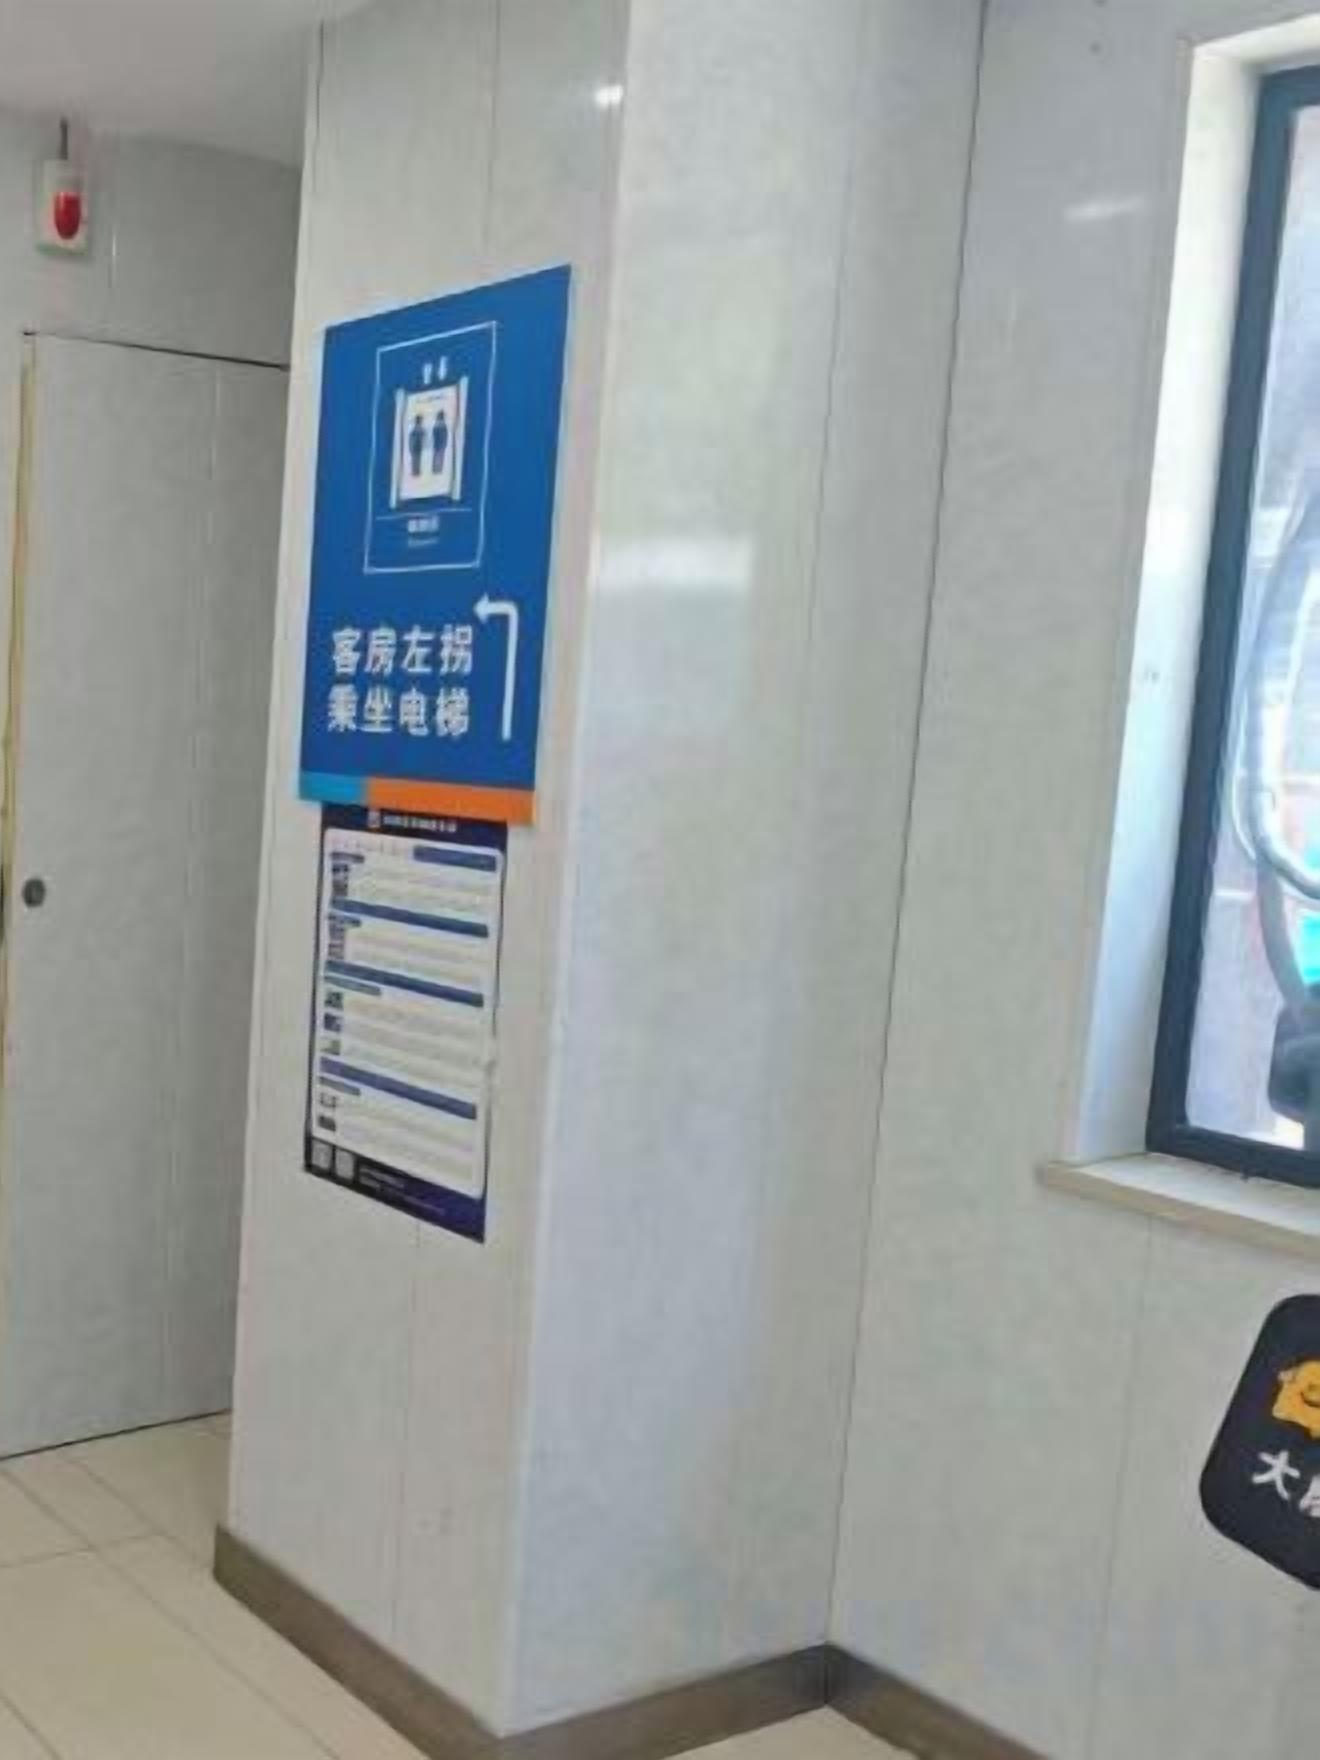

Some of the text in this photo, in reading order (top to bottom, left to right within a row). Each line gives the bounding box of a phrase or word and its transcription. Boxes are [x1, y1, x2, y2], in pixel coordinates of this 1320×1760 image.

[332, 624, 473, 677] 客房左拐
[327, 683, 470, 737] 乘坐电梯
